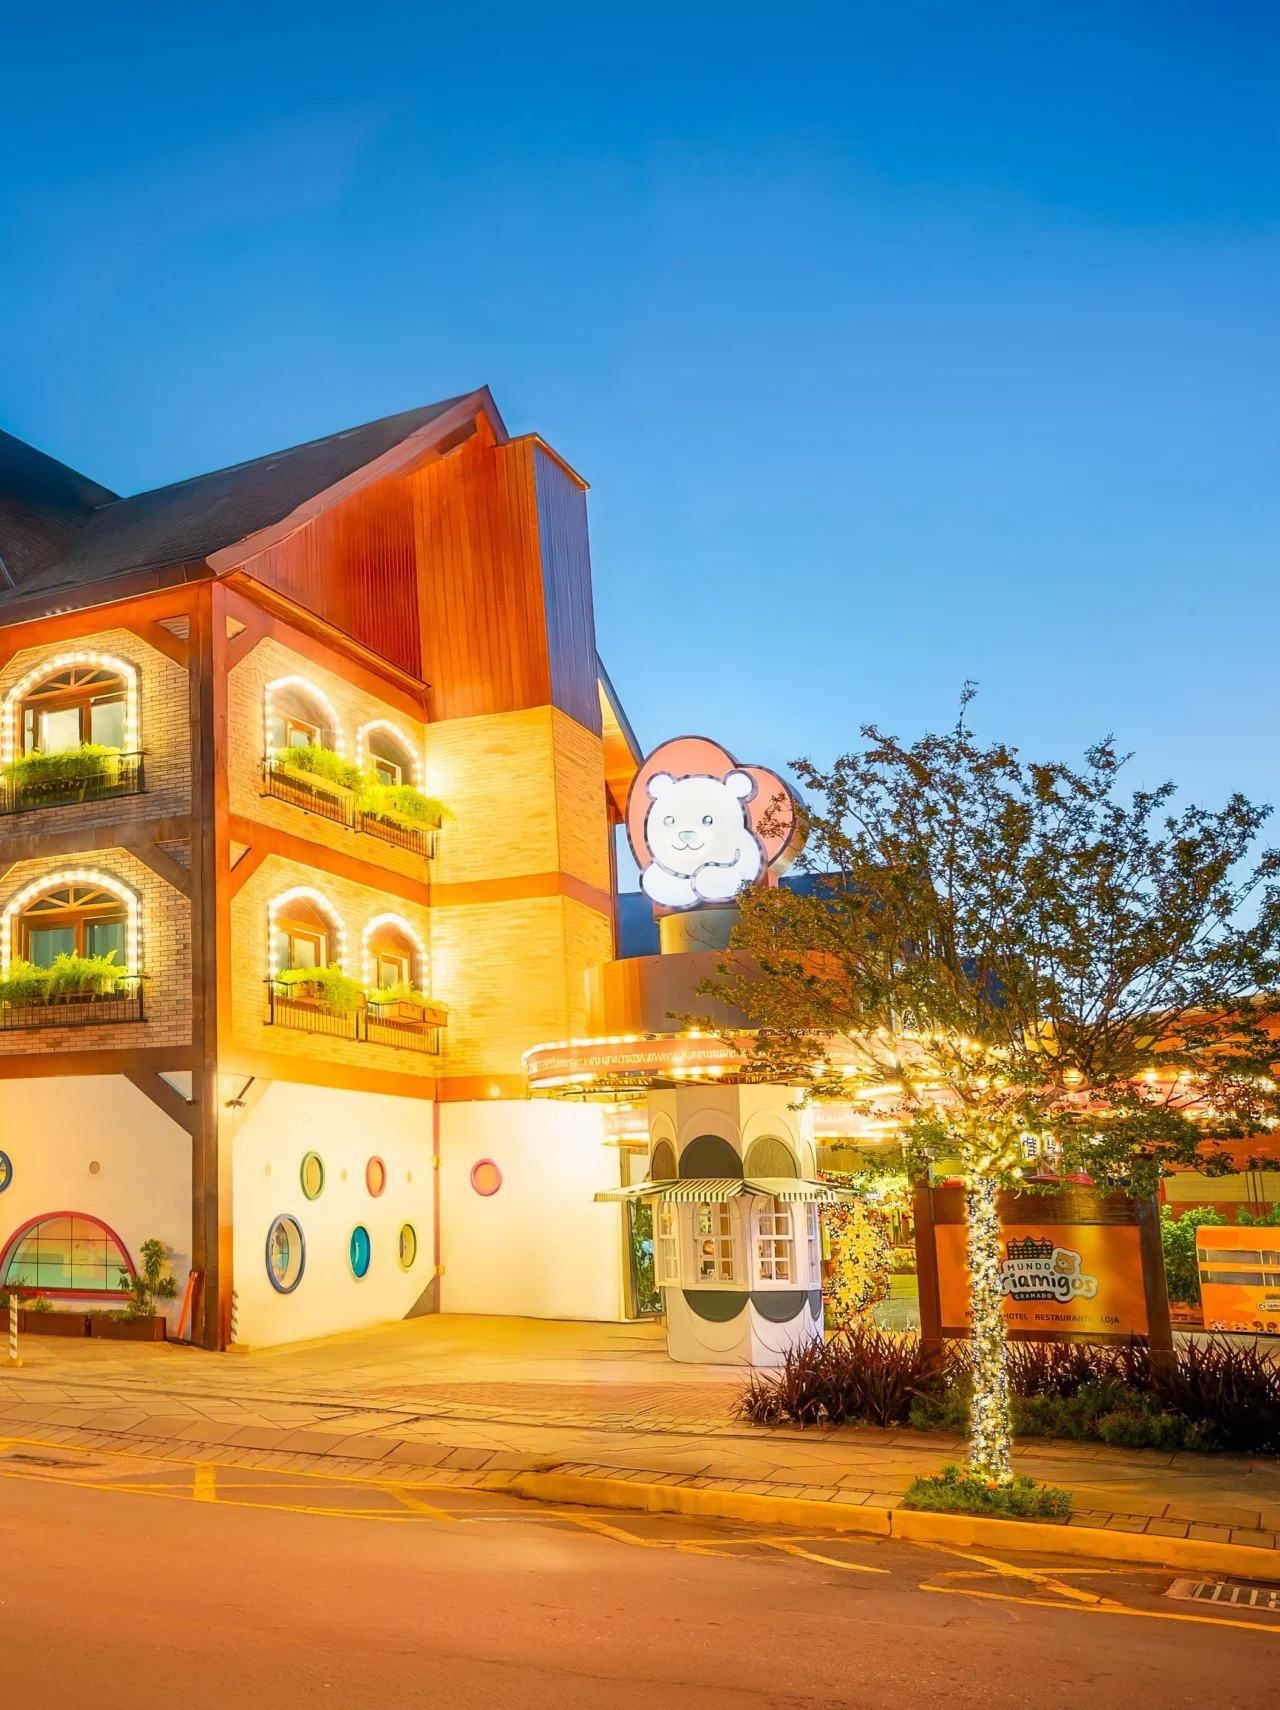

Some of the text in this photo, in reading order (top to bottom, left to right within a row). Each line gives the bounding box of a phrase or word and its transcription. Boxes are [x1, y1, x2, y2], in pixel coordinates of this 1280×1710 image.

[1007, 1262, 1051, 1271] MUNDO
[1001, 1271, 1093, 1296] riamigos
[1014, 1292, 1052, 1300] GRAMADO
[1003, 1312, 1029, 1320] HOTEL
[1035, 1313, 1094, 1323] RESTAURANTE
[1101, 1315, 1120, 1325] LOJA
